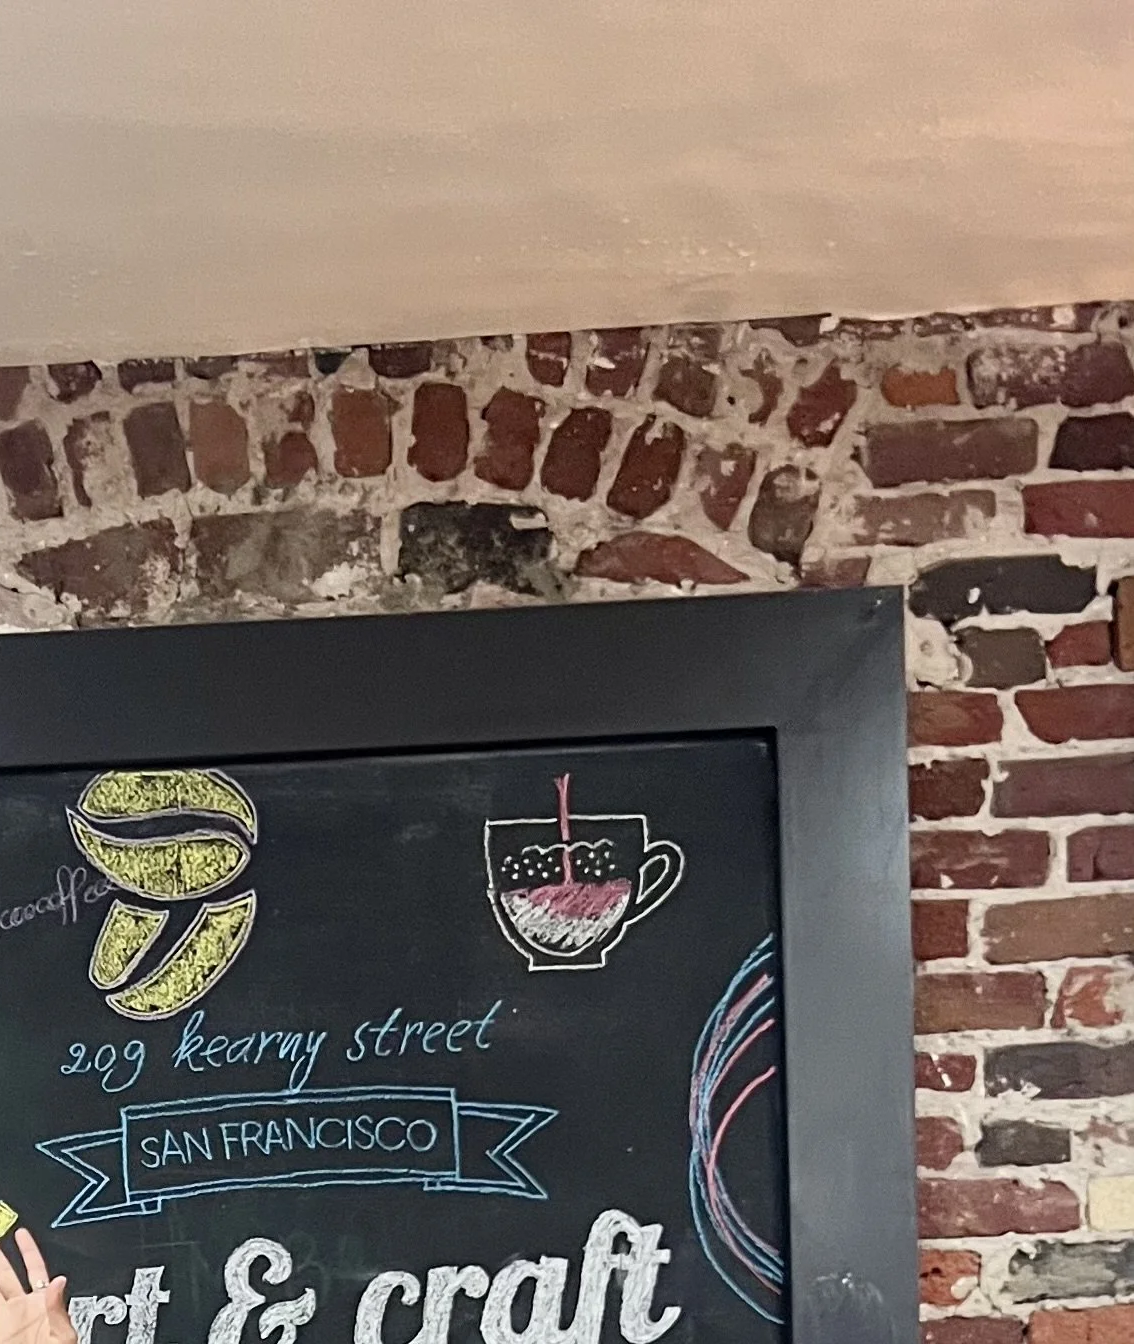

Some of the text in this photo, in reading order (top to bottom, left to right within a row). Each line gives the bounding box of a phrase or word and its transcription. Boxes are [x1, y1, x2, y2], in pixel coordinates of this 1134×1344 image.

[60, 1000, 503, 1093] 209 kearny street
[140, 1113, 438, 1168] SAN FRANCISCO
